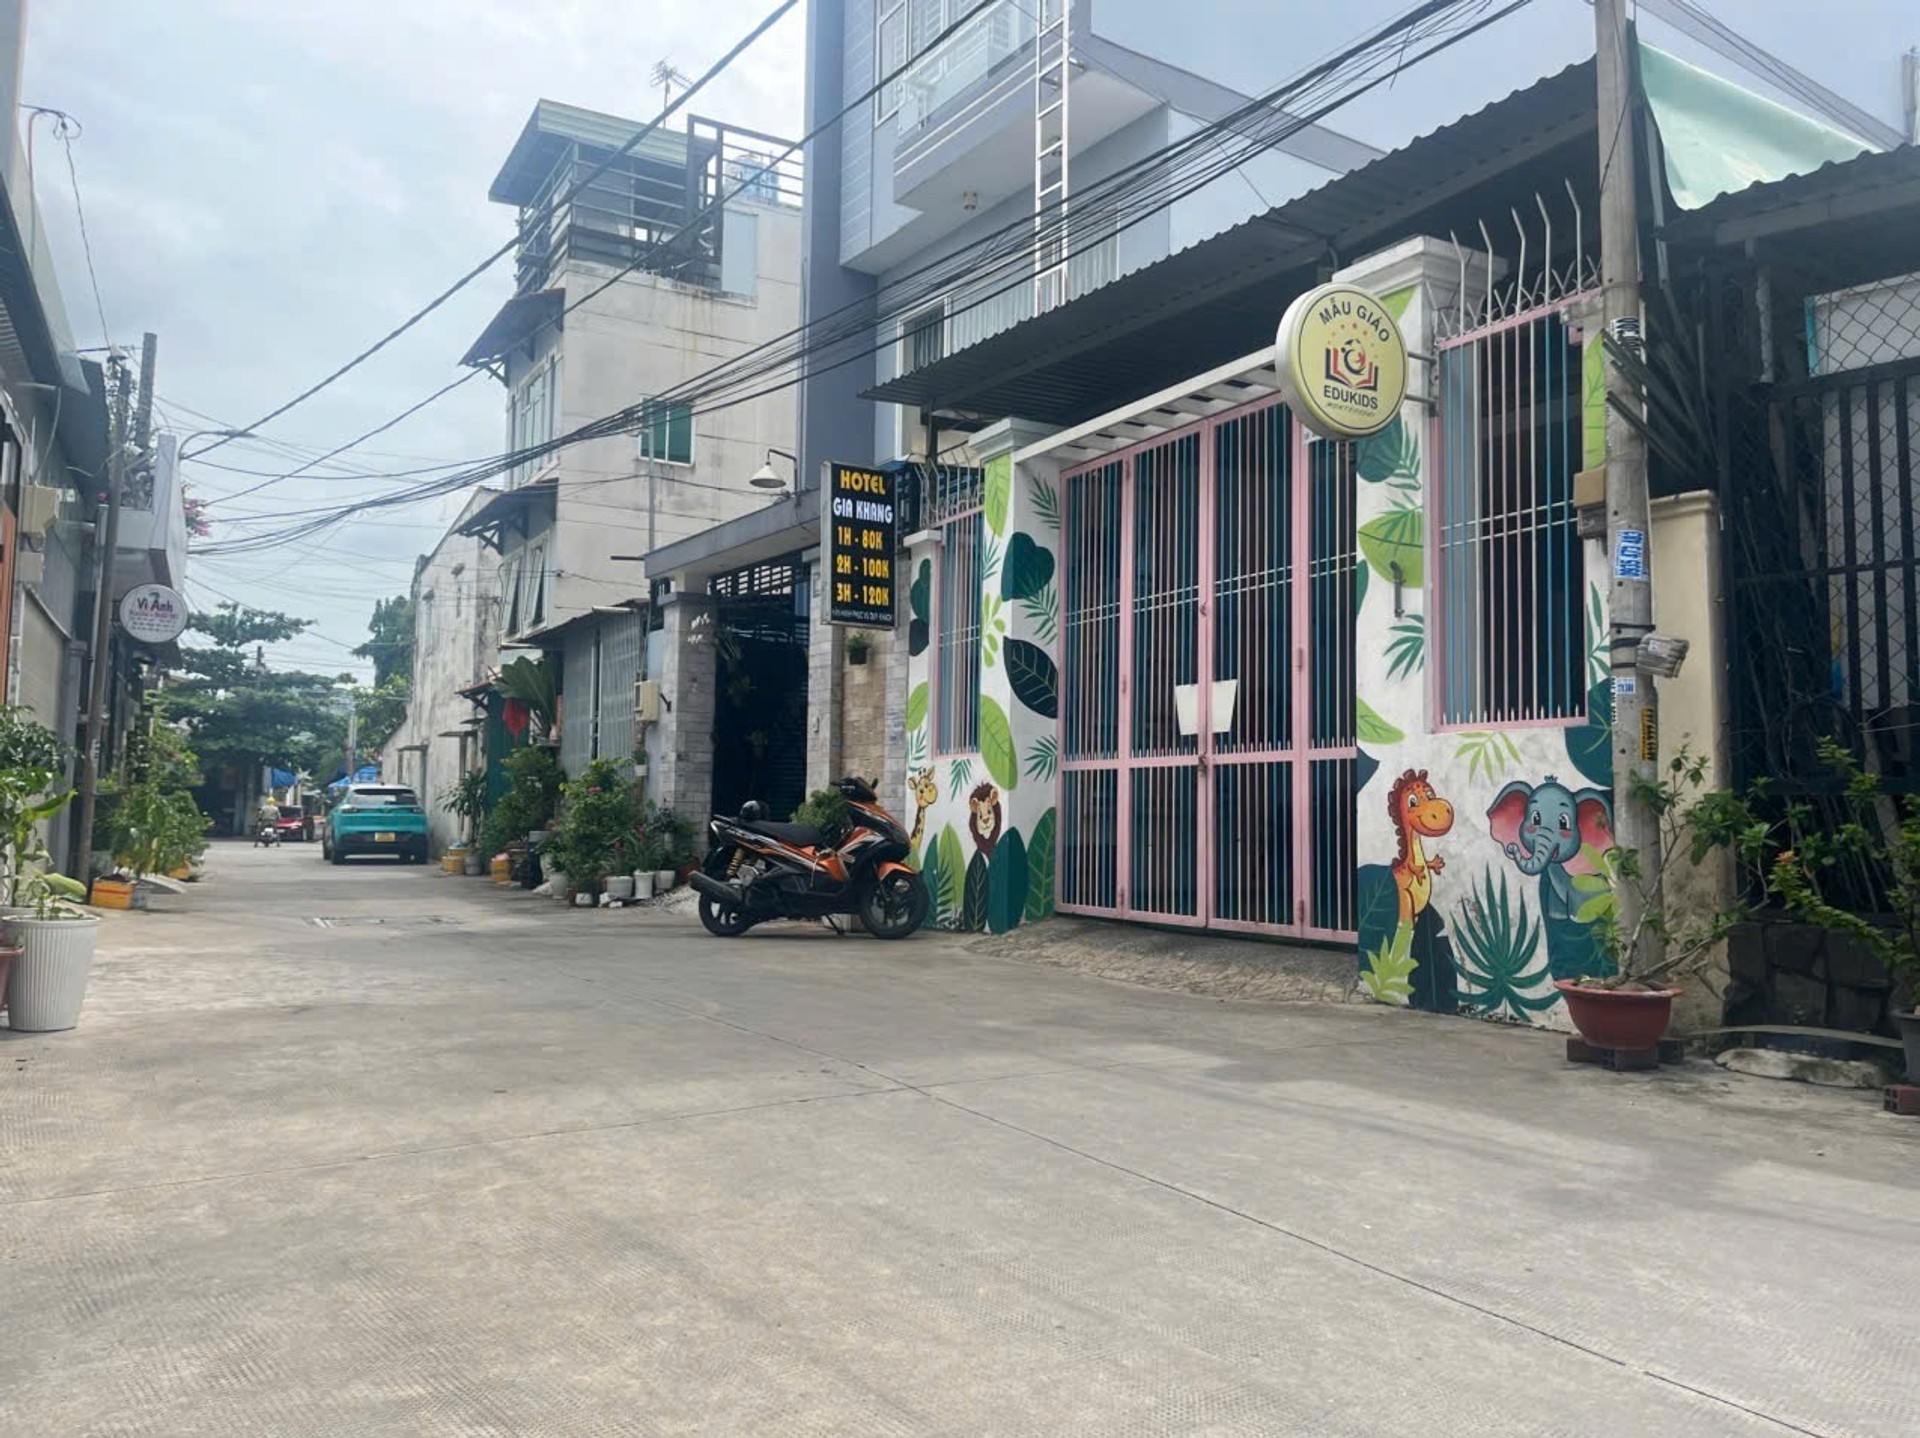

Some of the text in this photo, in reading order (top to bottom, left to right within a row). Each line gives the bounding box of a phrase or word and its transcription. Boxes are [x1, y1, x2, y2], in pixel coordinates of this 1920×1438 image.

[1357, 305, 1390, 342] GIÁO
[1324, 385, 1378, 410] EDUKIDS
[840, 469, 886, 495] HOTEL
[833, 497, 893, 524] GIA KHANG
[838, 526, 852, 546] 1H
[862, 529, 883, 550] 80K
[836, 554, 852, 574] 2H
[863, 557, 889, 579] 100K
[836, 582, 852, 603] 3H
[863, 585, 889, 607] 120K
